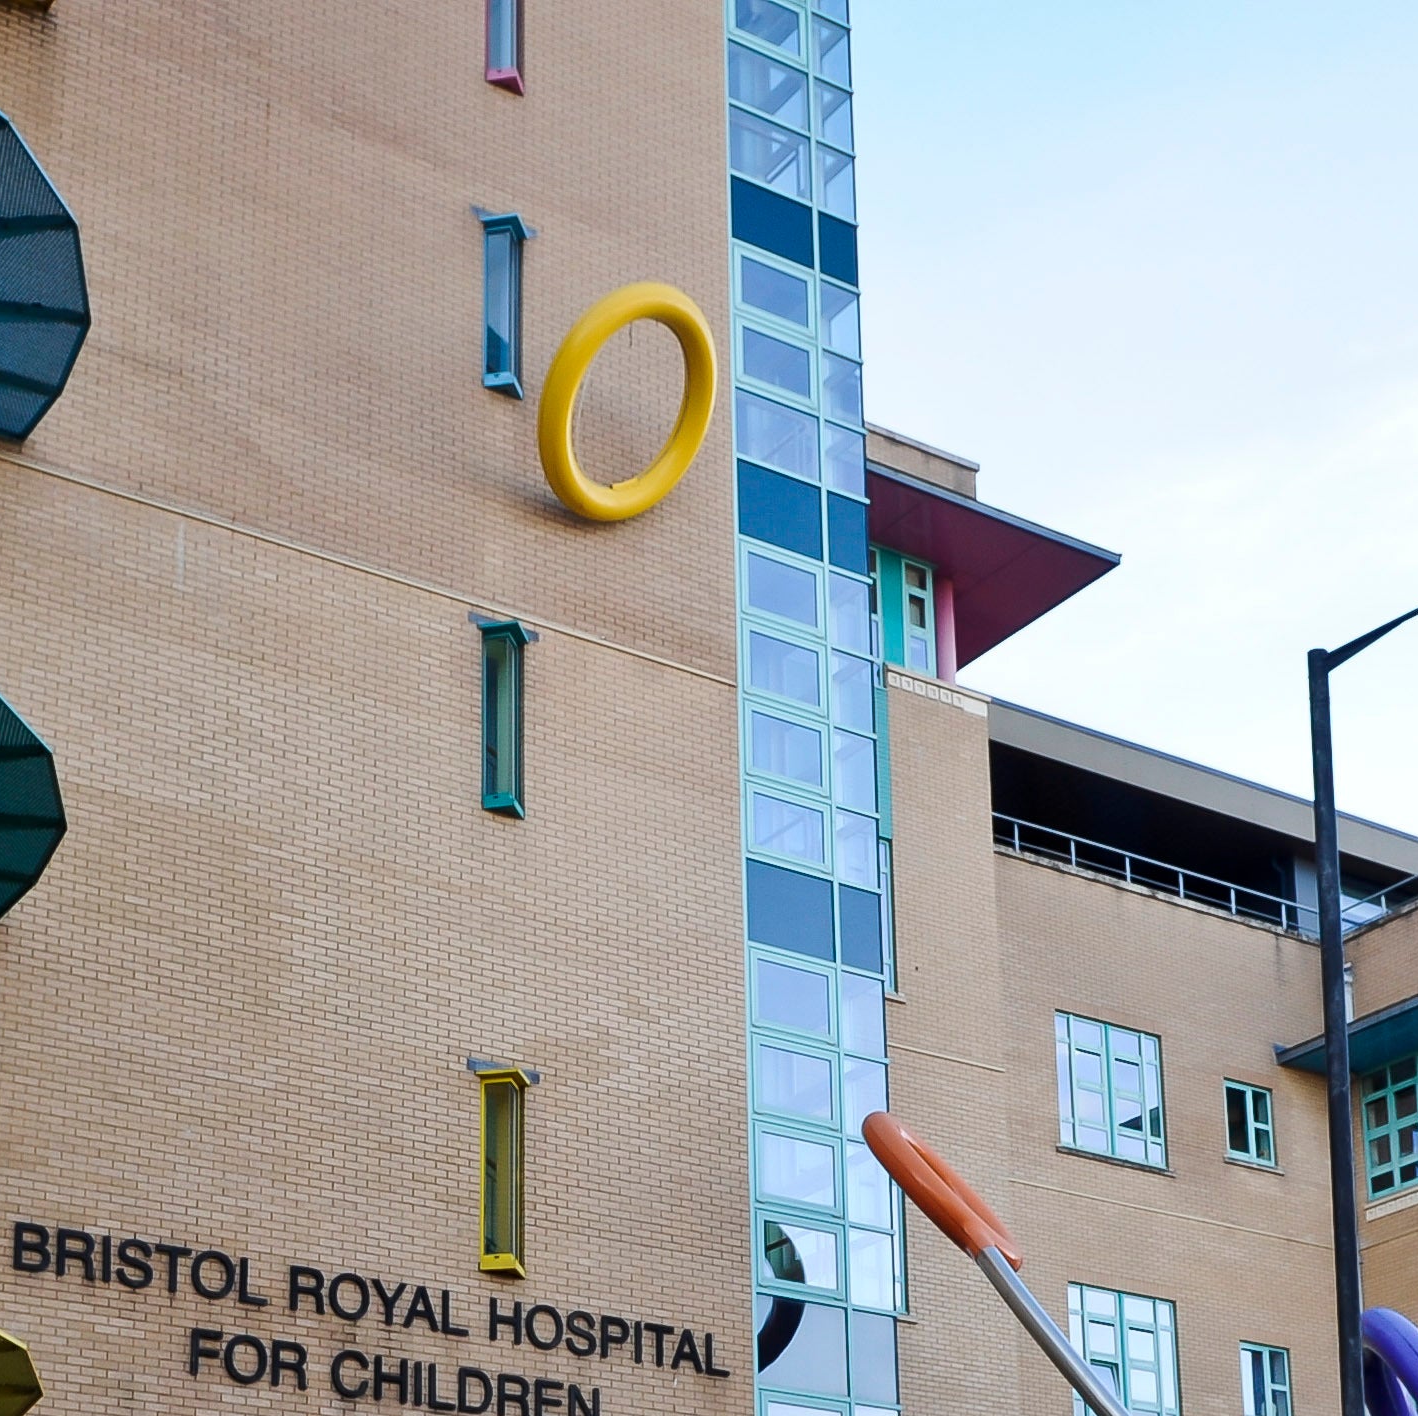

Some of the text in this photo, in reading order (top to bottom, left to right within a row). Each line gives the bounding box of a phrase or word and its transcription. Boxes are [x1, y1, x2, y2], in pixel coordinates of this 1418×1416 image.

[13, 1222, 730, 1378] BRISTOL ROYAL HOSPITAL
[189, 1328, 308, 1391] FOR
